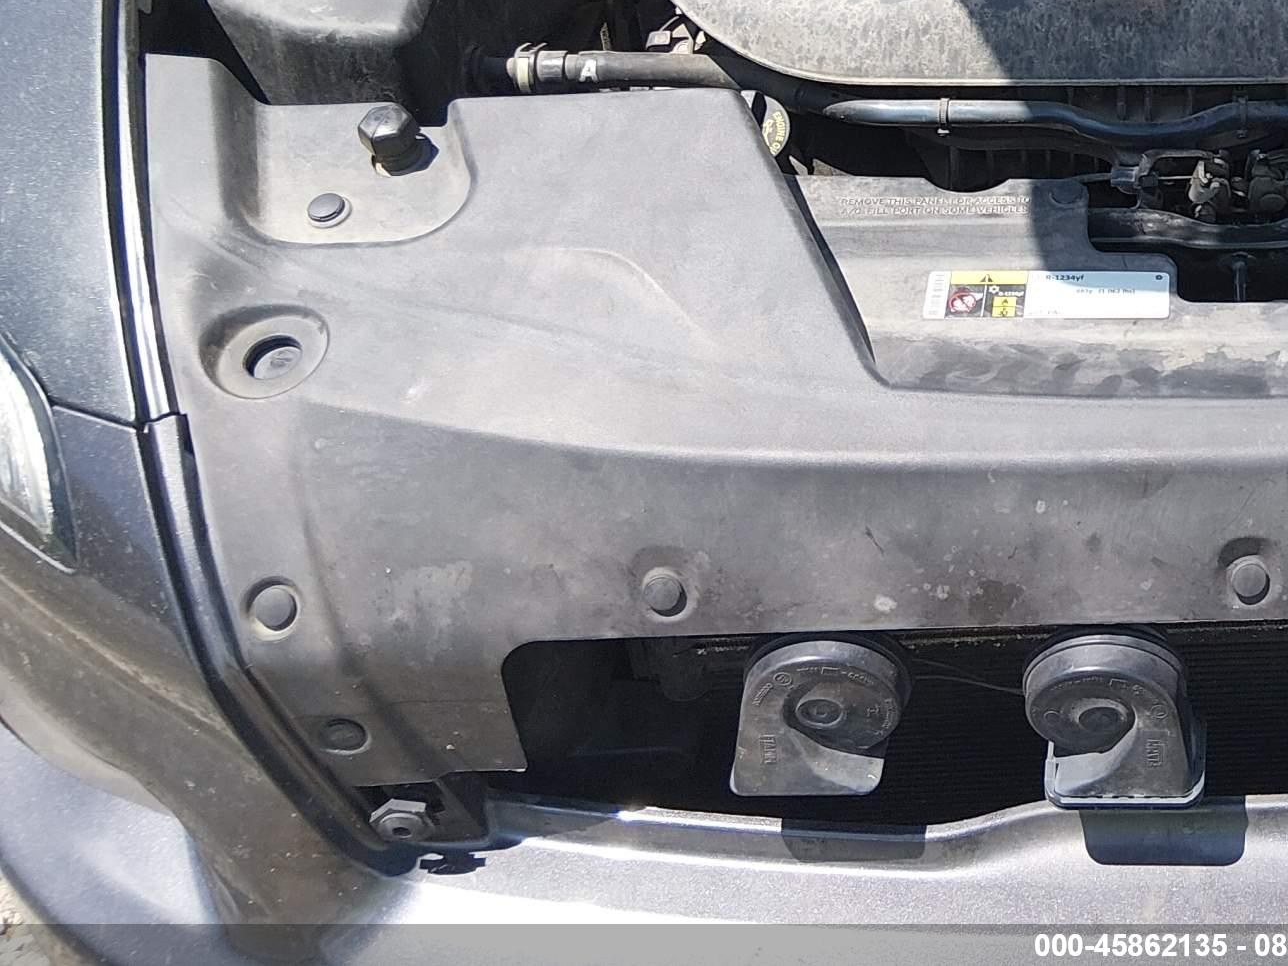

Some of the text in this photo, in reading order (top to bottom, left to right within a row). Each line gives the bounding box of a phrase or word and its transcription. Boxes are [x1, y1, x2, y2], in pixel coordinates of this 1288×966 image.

[579, 59, 599, 83] A
[772, 112, 785, 141] ENGINE
[840, 197, 886, 206] REMOVE
[887, 197, 912, 206] THIS
[951, 197, 974, 205] FOR
[975, 197, 1016, 205] ACCESS
[866, 207, 889, 215] FILL
[893, 207, 920, 215] PORT
[923, 207, 940, 215] ON
[944, 207, 974, 215] SOME
[976, 206, 1029, 215] VEHICLES
